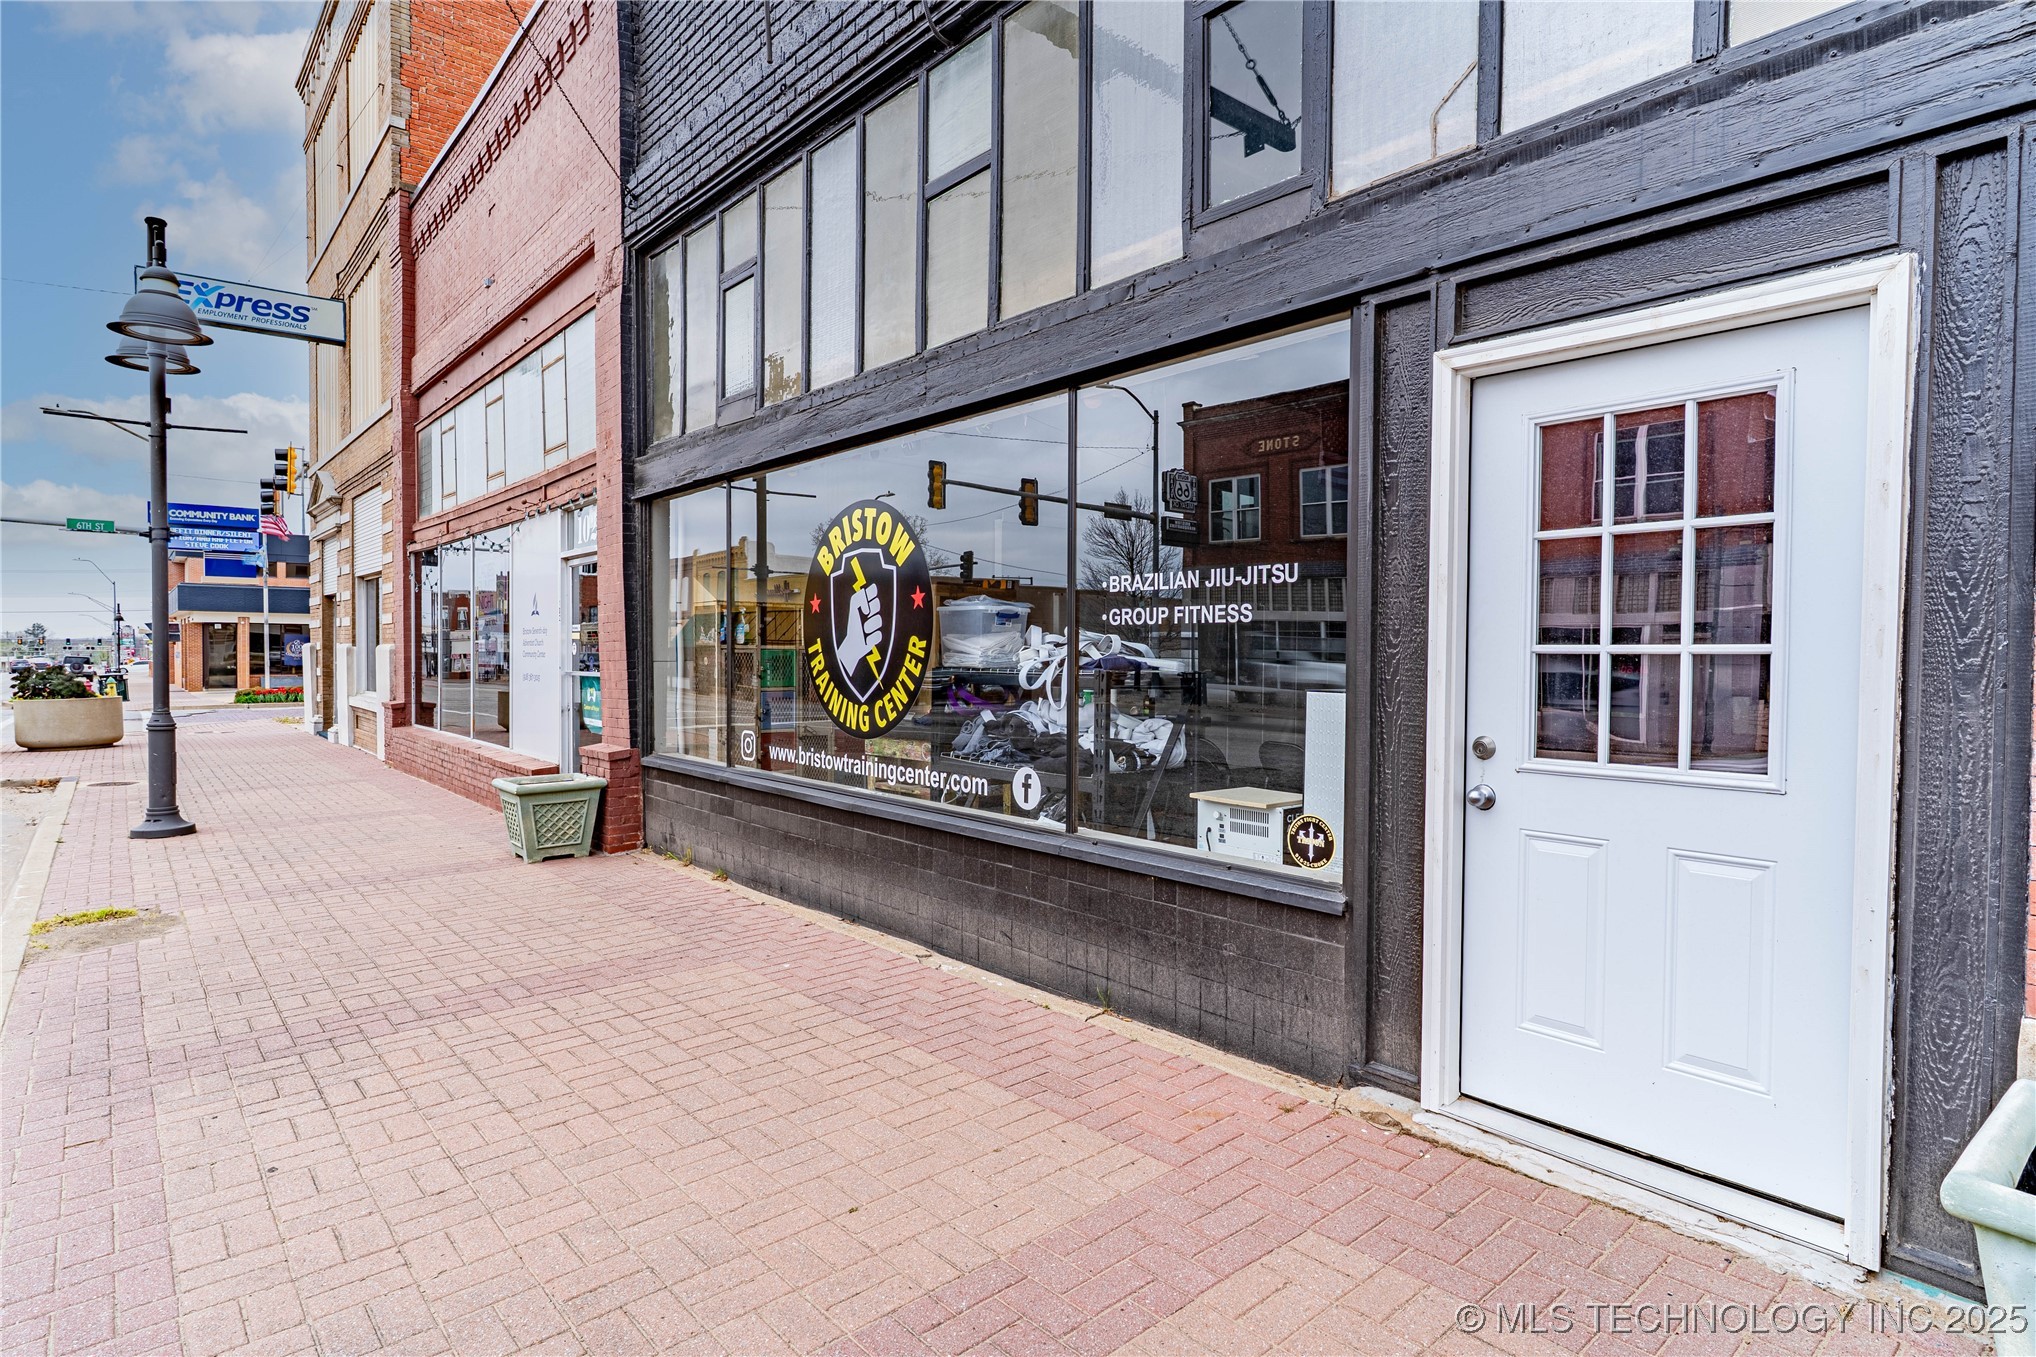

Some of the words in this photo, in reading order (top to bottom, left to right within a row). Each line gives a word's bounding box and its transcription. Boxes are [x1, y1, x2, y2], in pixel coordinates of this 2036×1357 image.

[197, 308, 249, 321] EMPLOYMENT
[251, 317, 307, 331] PROFESSIONALS
[76, 522, 92, 530] 6TH
[95, 523, 105, 531] ST
[168, 509, 228, 520] COMMUNITY
[229, 513, 256, 521] BANK
[185, 541, 209, 549] STEVE
[816, 507, 915, 577] BRISTOW
[1109, 570, 1200, 592] BRAZILIAN
[1205, 563, 1299, 588] JIU-JITSU
[1109, 607, 1169, 626] GROUP
[1174, 603, 1253, 624] FITNESS
[807, 638, 870, 733] TRAINING
[874, 634, 927, 728] CENTER
[768, 744, 988, 797] www.bristowtrainingcenter.com
[1319, 820, 1333, 842] CENTER
